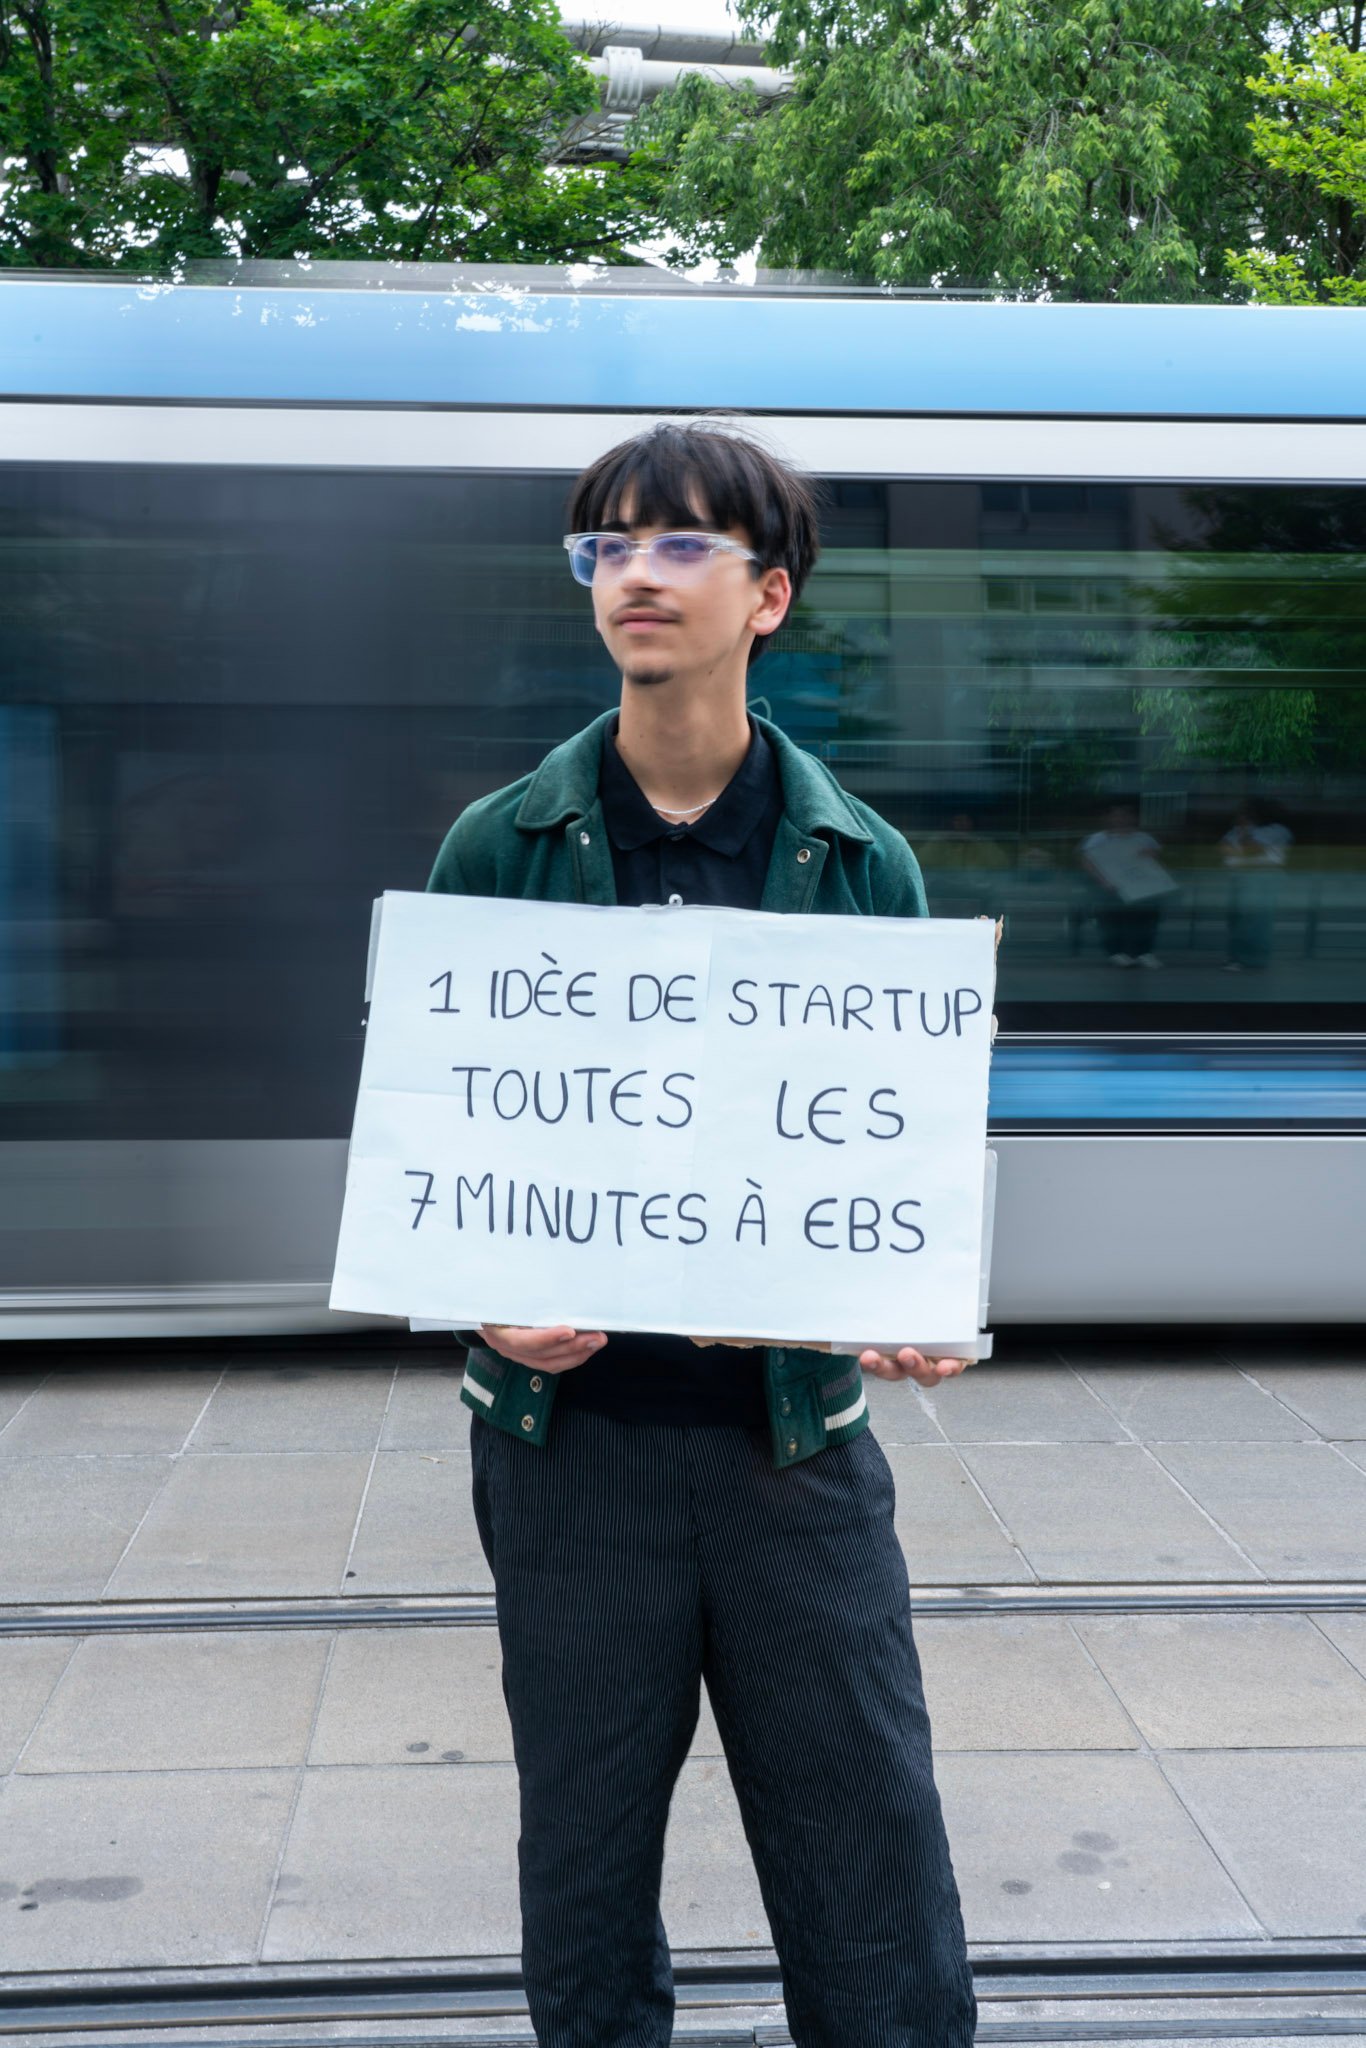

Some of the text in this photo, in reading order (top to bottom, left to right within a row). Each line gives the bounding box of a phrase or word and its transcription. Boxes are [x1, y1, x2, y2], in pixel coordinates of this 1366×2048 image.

[430, 971, 460, 1013] 1
[629, 974, 696, 1022] DE
[729, 980, 981, 1036] STARTUP
[452, 1067, 904, 1144] TOUTES LES
[405, 1171, 924, 1253] 7 MINUTES À EBS
